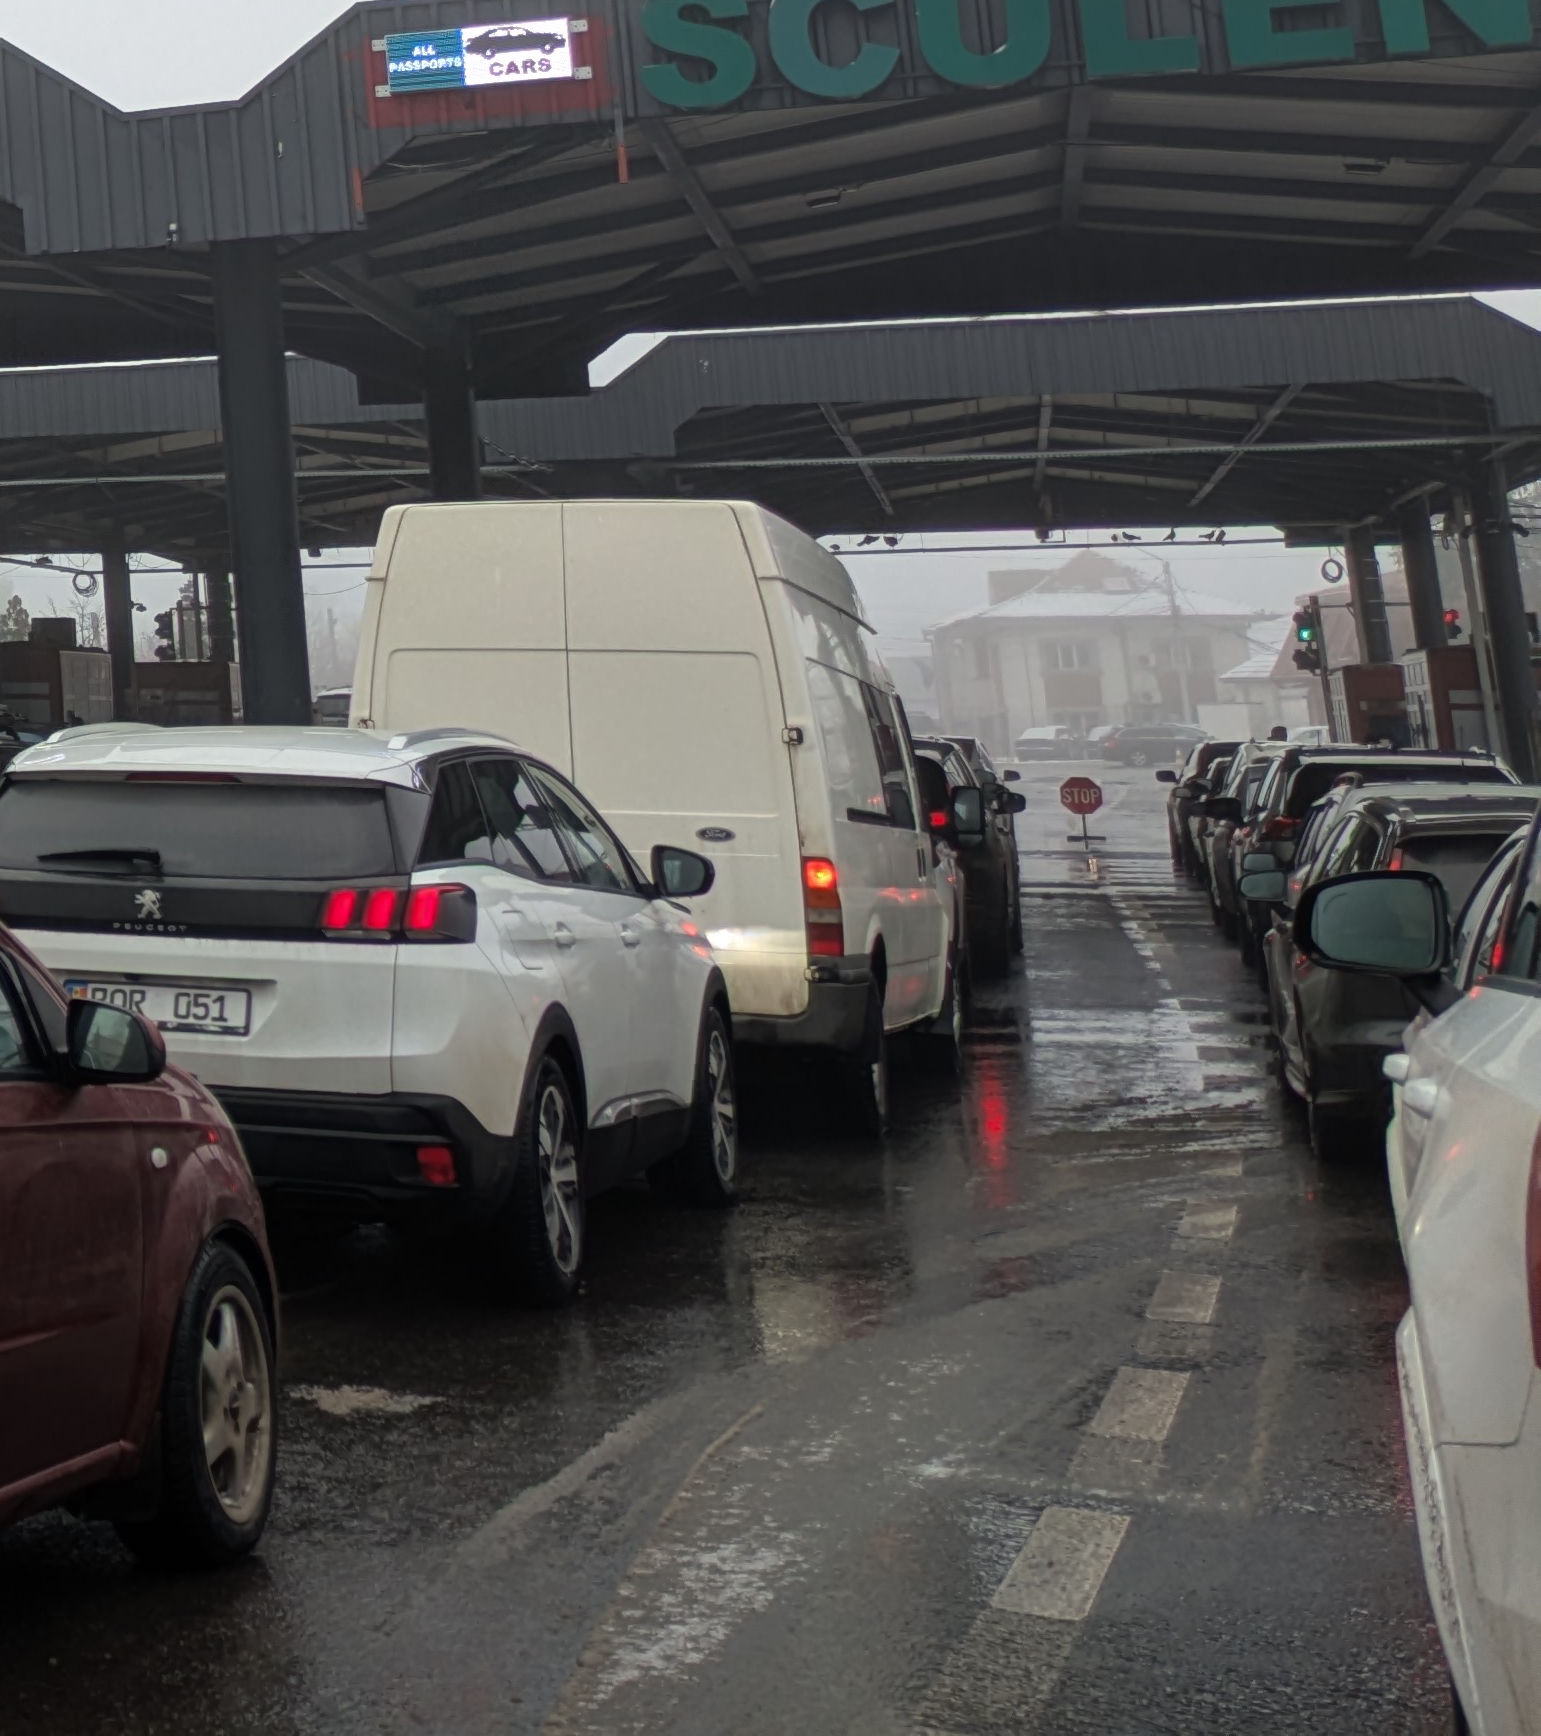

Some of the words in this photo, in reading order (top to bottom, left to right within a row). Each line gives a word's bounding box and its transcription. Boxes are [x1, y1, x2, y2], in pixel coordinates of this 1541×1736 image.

[412, 45, 436, 57] ALL
[389, 58, 463, 73] PASSPORTS
[489, 58, 552, 76] CARS
[1062, 788, 1100, 804] STOP
[113, 922, 187, 932] PEUGEOT
[174, 991, 229, 1023] 051
